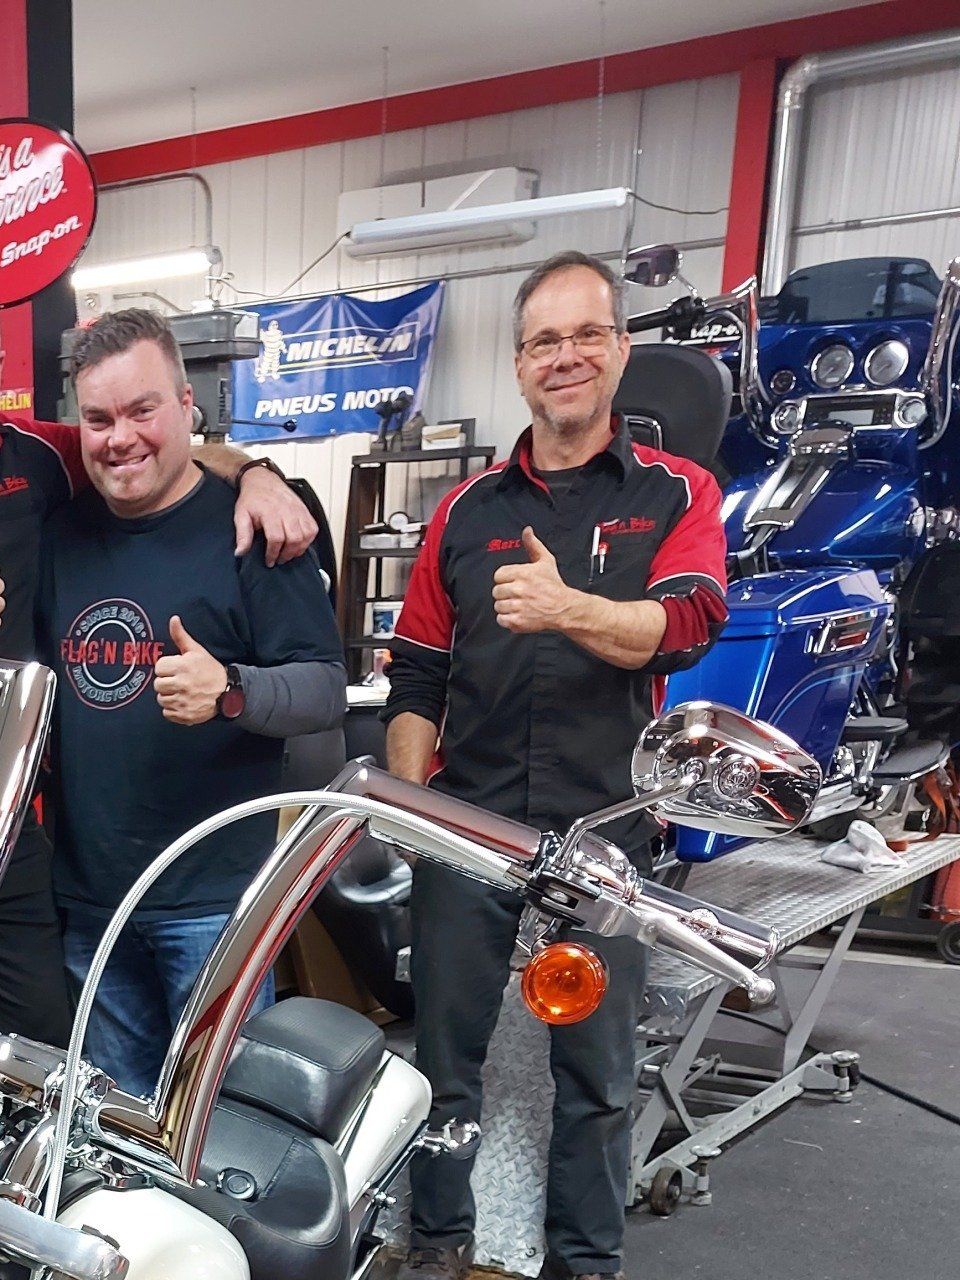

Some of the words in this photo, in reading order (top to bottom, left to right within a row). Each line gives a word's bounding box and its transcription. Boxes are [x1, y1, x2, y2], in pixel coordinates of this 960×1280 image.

[13, 136, 35, 171] a
[0, 215, 80, 268] Snap-on
[286, 331, 413, 363] MICHELIN
[254, 392, 338, 419] PNEUS
[80, 606, 119, 632] SINCE
[122, 641, 166, 666] BIKE
[72, 665, 146, 703] MOTORCYCLES
